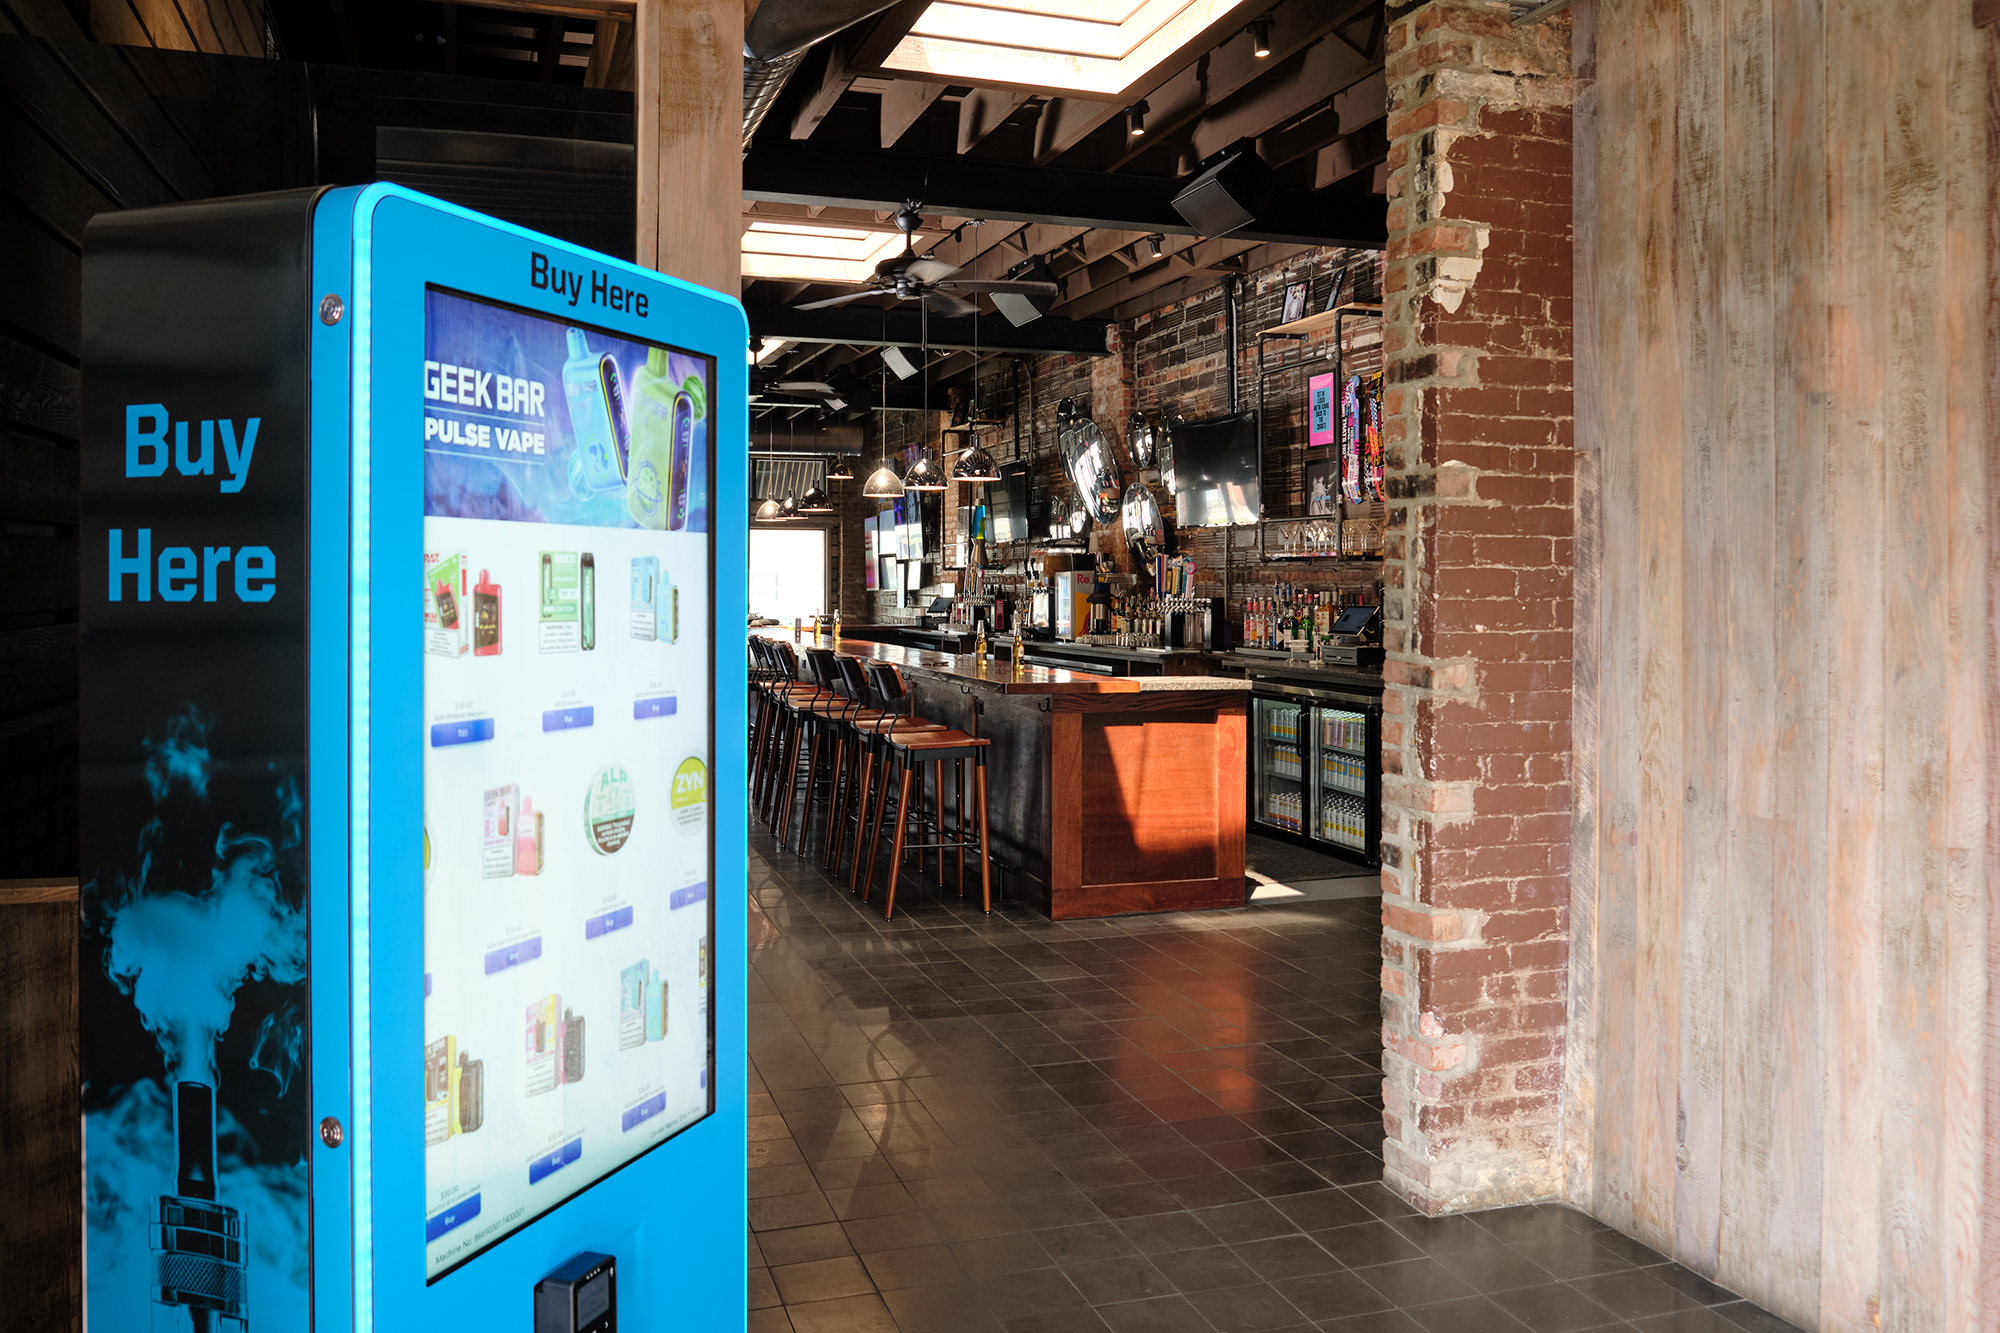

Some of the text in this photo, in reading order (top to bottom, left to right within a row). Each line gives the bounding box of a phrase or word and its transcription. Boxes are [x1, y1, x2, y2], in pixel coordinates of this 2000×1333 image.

[531, 251, 649, 318] Buy Here
[424, 360, 545, 417] GEEK BAR
[126, 403, 261, 493] Buy
[424, 417, 545, 455] PULSE VAPE
[108, 528, 276, 603] Here
[1077, 574, 1089, 584] Re
[676, 770, 704, 794] ZYN
[436, 1243, 462, 1264] Machine
